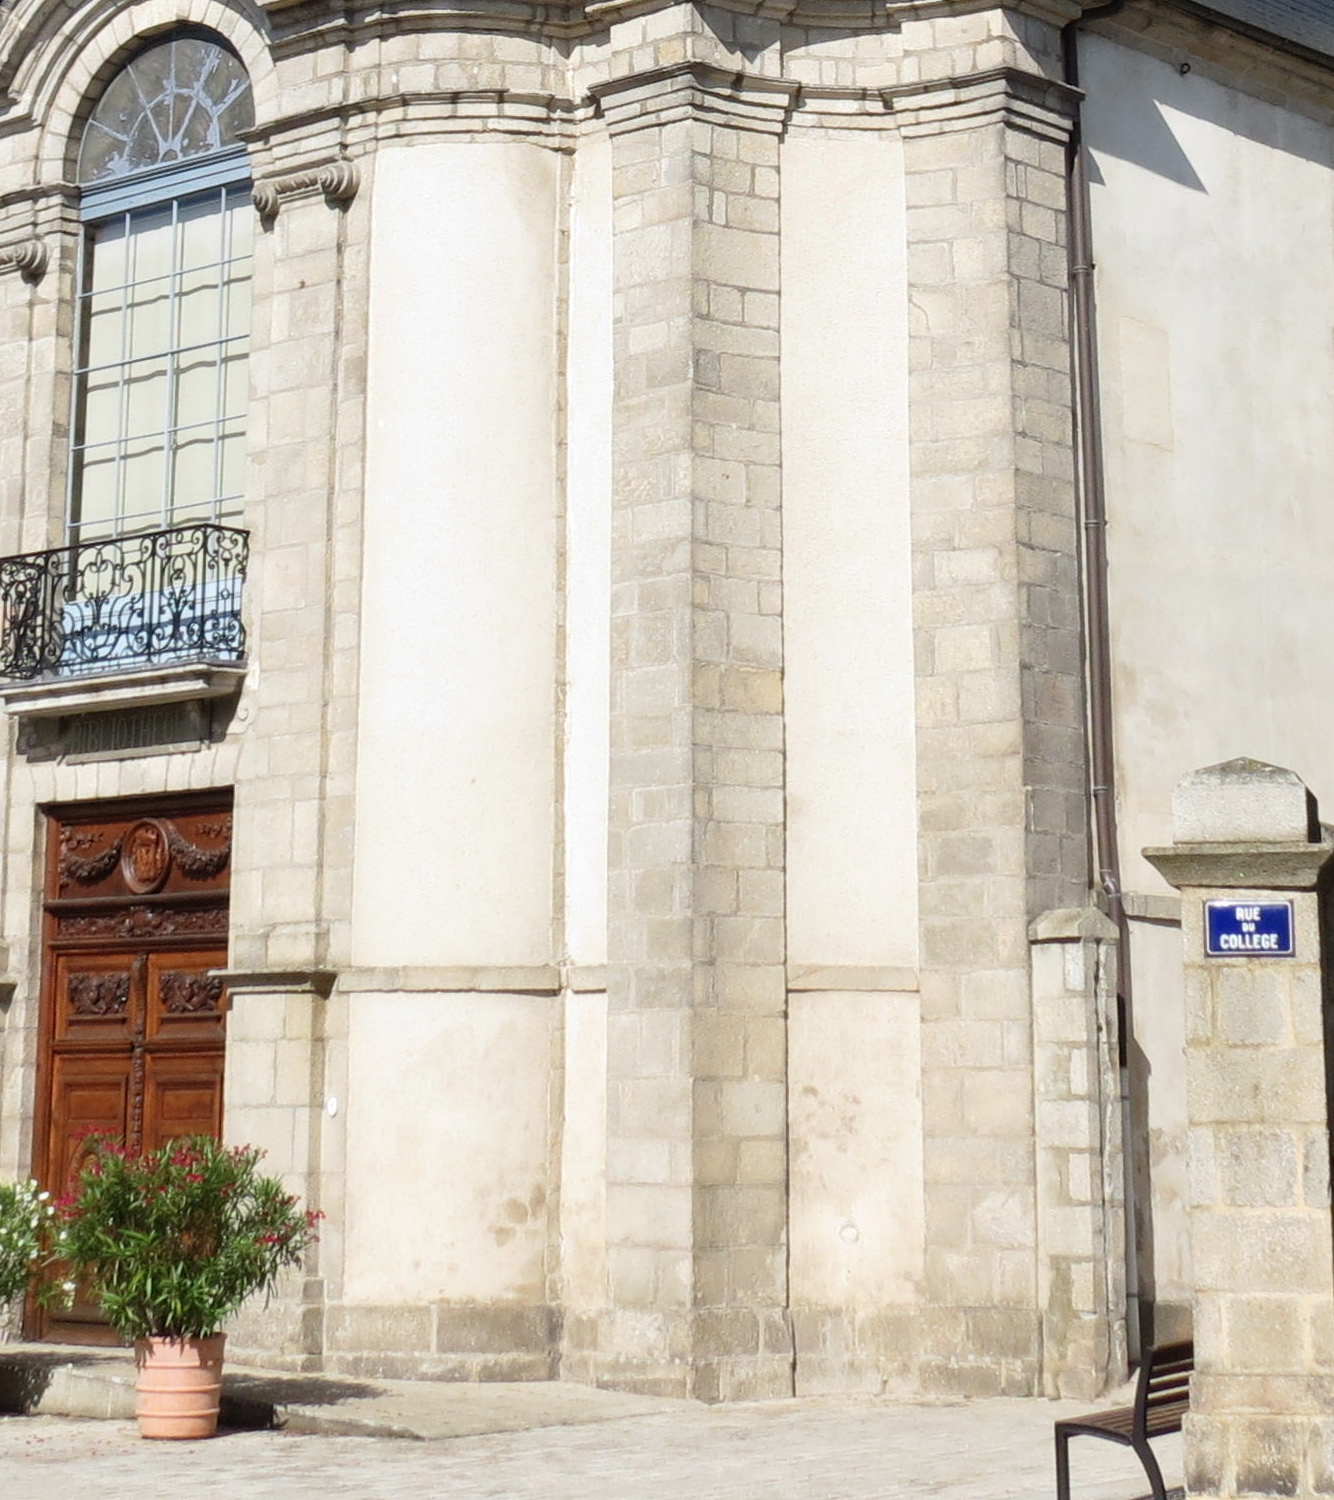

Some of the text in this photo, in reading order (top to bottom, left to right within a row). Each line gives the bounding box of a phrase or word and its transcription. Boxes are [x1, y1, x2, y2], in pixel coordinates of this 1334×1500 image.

[69, 709, 191, 754] BIBLIOTHEQ
[1235, 907, 1261, 921] RUE
[1241, 922, 1256, 932] DU
[1219, 933, 1279, 949] COLLEGE
